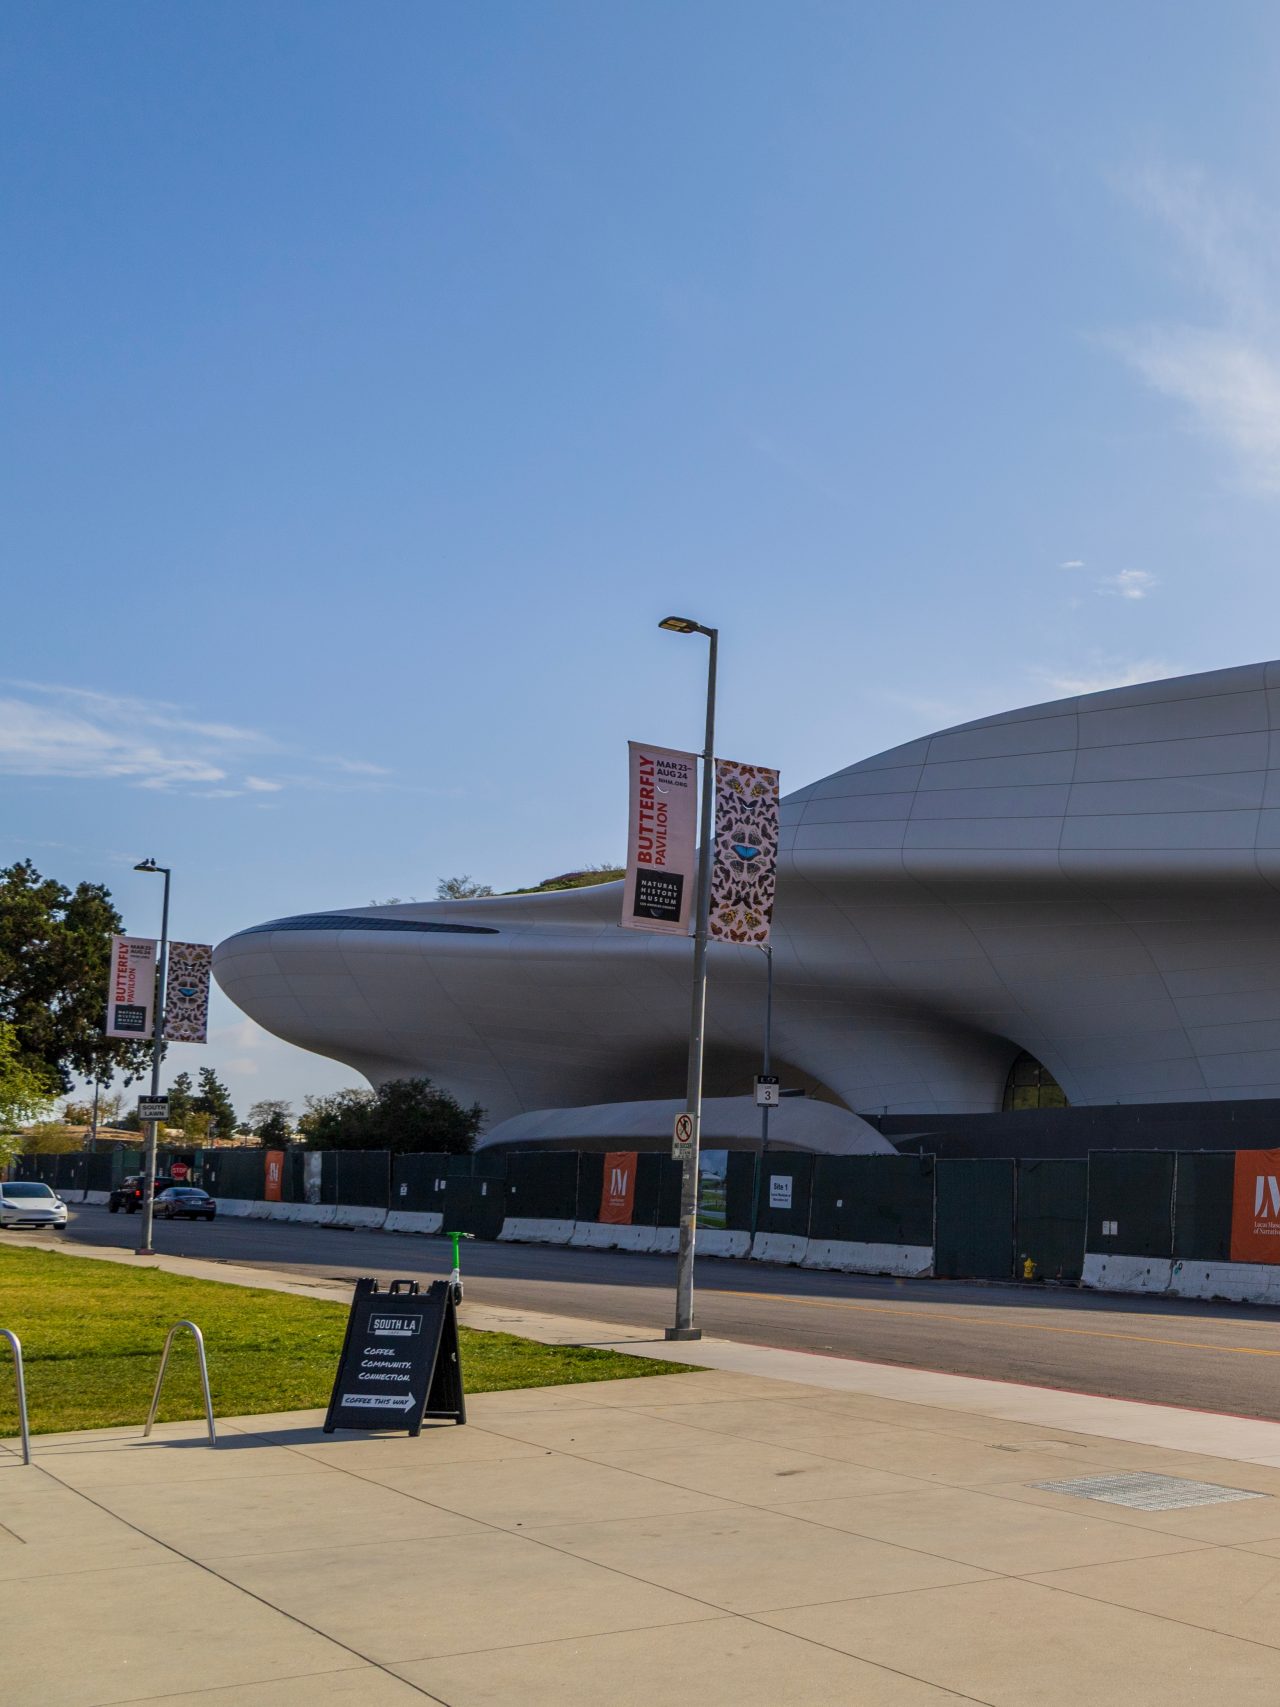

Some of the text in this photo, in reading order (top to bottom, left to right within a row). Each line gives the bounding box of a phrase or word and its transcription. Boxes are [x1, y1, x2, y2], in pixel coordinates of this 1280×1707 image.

[656, 760, 677, 771] MAR
[656, 768, 688, 780] AUG 24
[658, 777, 688, 788] NHM.ORG
[637, 755, 654, 864] BUTTERFLY
[655, 802, 668, 865] PAVILION
[641, 880, 678, 891] NATURAL
[640, 887, 678, 898] HISTORY
[640, 894, 677, 905] MUSEUM
[115, 942, 129, 1003] BUTTERFLY
[127, 968, 136, 1003] PAVILION
[764, 1090, 772, 1101] 3
[773, 1182, 784, 1191] Site
[373, 1319, 416, 1330] SOUTH LA
